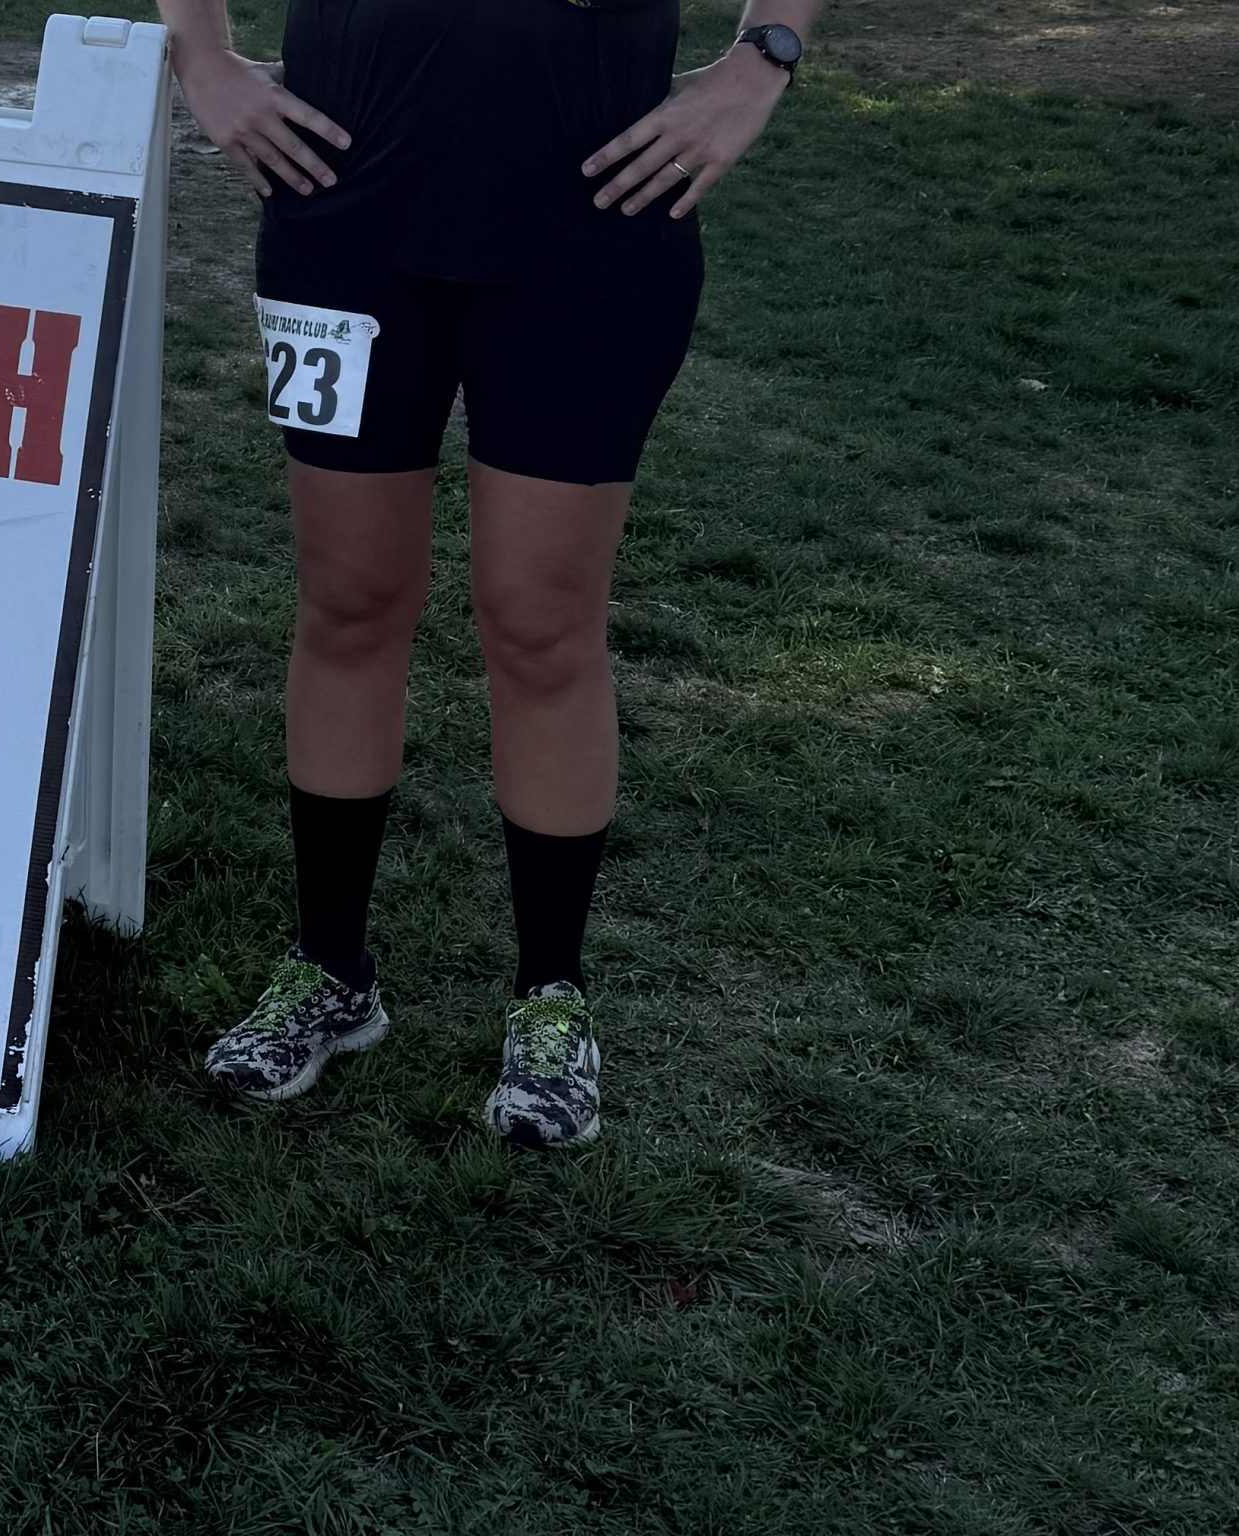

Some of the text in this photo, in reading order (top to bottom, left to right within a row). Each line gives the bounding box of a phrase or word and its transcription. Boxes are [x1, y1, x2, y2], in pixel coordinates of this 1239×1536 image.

[278, 315, 303, 336] TRACK
[303, 319, 328, 339] CLUB
[265, 337, 341, 426] 23
